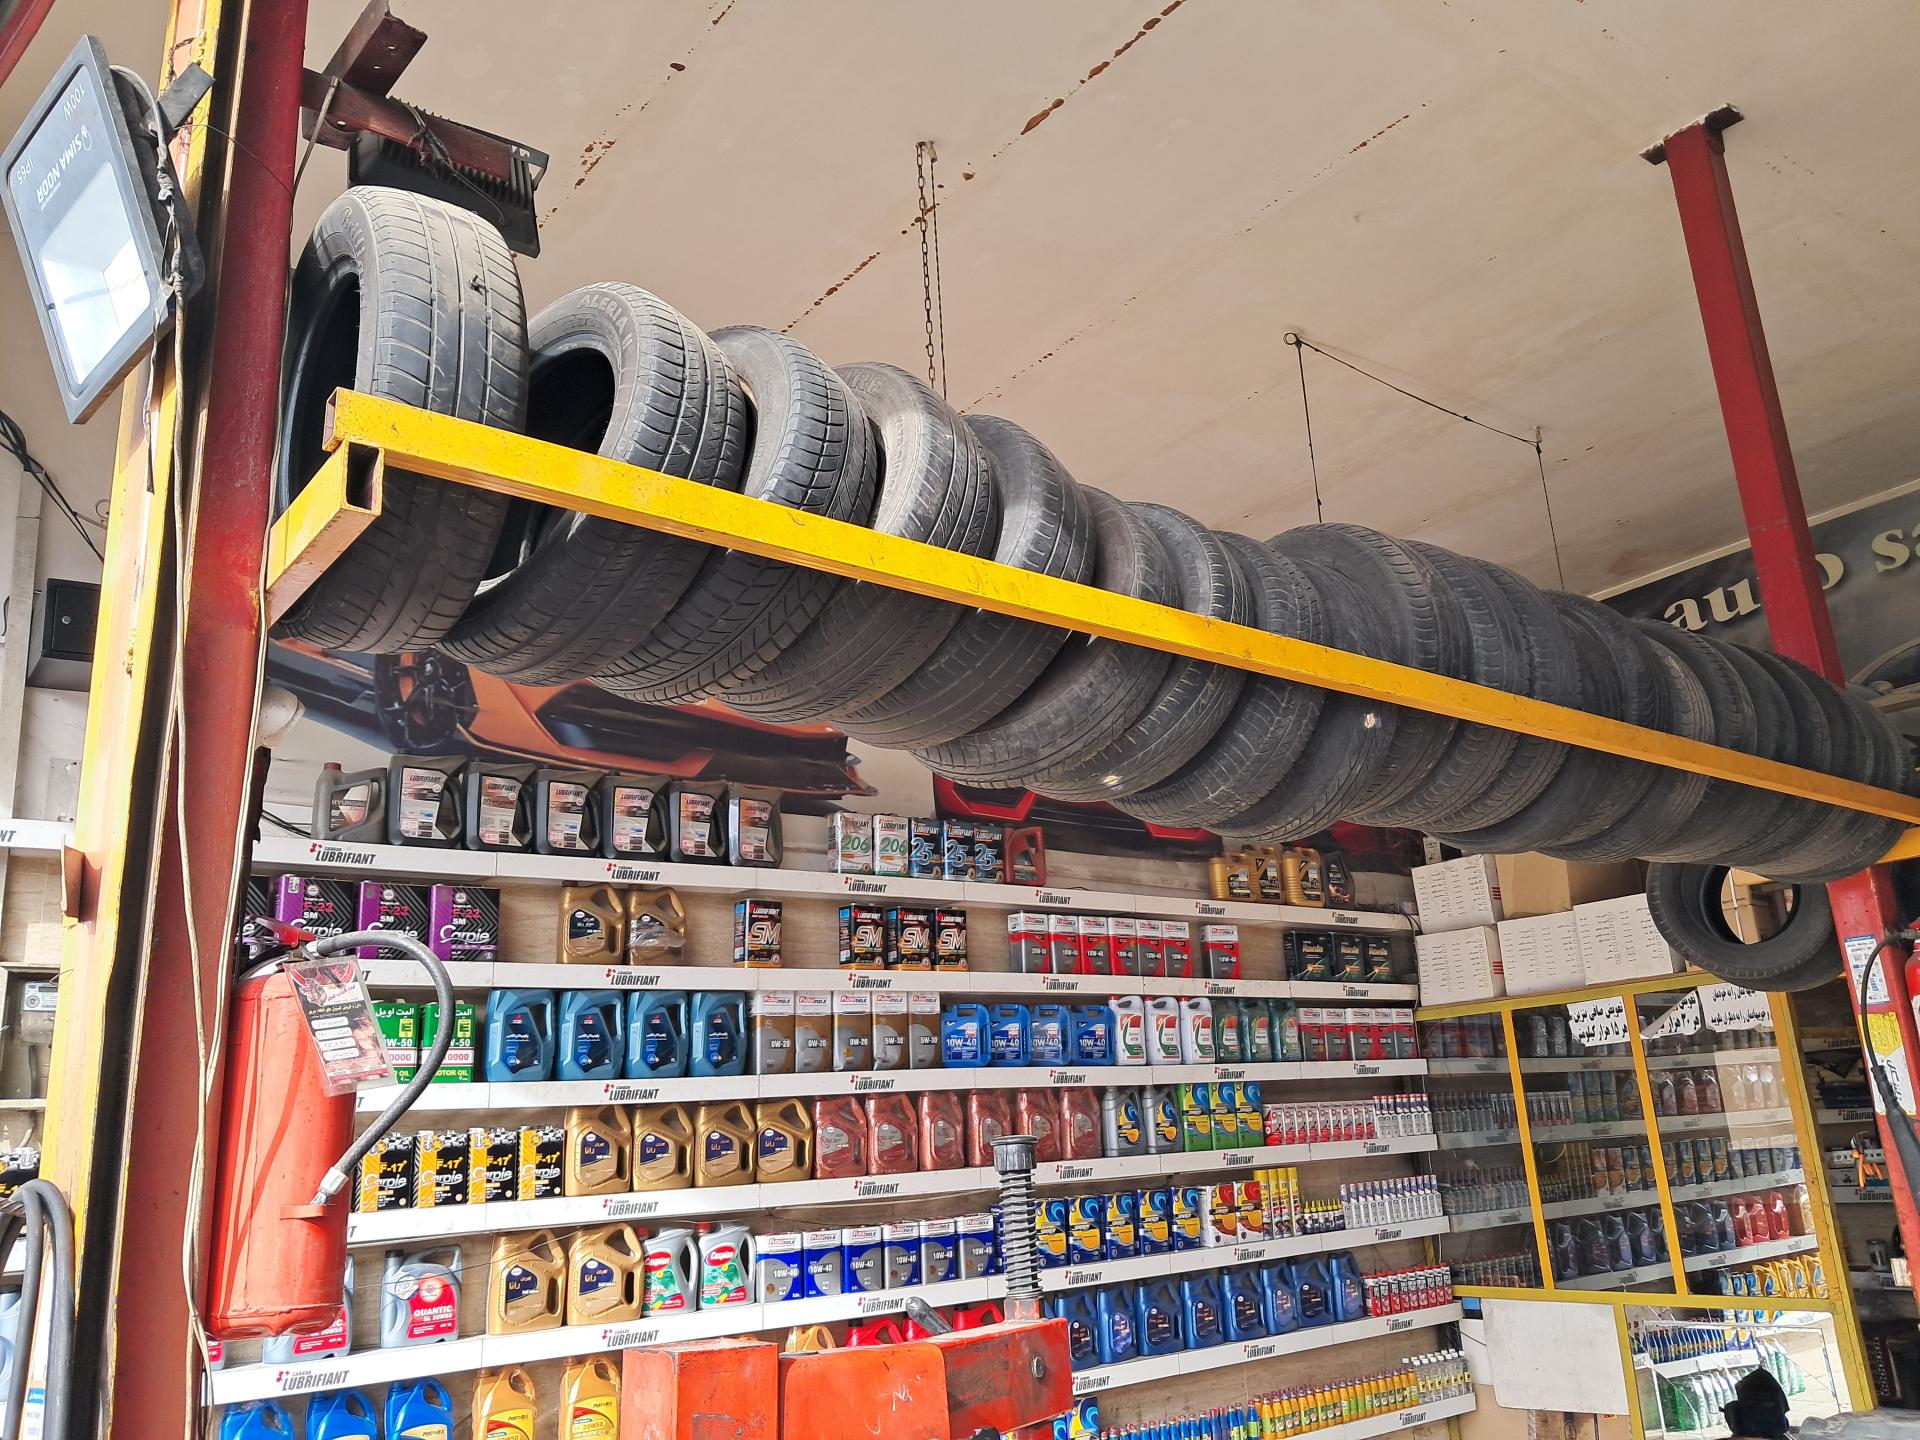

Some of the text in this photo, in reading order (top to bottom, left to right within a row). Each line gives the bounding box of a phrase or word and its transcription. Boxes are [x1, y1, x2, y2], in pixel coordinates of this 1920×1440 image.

[63, 84, 85, 120] 100W
[59, 134, 82, 171] SIMA
[16, 155, 34, 185] IP65
[36, 163, 61, 203] NOOR
[1663, 523, 1920, 631] auo s
[842, 836, 871, 852] 206
[880, 837, 907, 853] 206
[315, 850, 376, 865] LUBRIFIANT
[910, 837, 935, 866] 25
[944, 840, 967, 867] 25
[974, 843, 998, 871] 25
[611, 869, 661, 882] LUBRIFIANT
[849, 883, 888, 894] LUBRIFIANT
[1038, 894, 1072, 905] LUBRIFIANT
[303, 911, 318, 920] SM
[380, 915, 394, 923] SM
[749, 921, 781, 945] SM
[855, 926, 883, 948] SM
[902, 928, 930, 949] SM
[940, 928, 966, 950] SM
[610, 975, 661, 987] LUBRIFIANT
[852, 979, 892, 989] LUBRIFIANT
[1046, 979, 1079, 991] LUBRIFIANT
[375, 1007, 414, 1018] الیت اویل
[1574, 1001, 1623, 1023] تعویض صافی بنزین
[1610, 1020, 1619, 1035] ۱۵
[1668, 1015, 1680, 1033] هزار
[1693, 1015, 1700, 1030] هر
[1599, 1023, 1610, 1041] هزار
[1622, 1023, 1628, 1038] هر
[946, 1038, 977, 1047] 10W-40
[1032, 1038, 1059, 1048] 0W-40
[1079, 1038, 1106, 1047] 10W-40
[854, 1080, 895, 1091] LUBRIFIANT
[1053, 1074, 1087, 1084] LUBRIFIANT
[609, 1088, 660, 1101] LUBRIFIANT
[1059, 1168, 1093, 1179] LUBRIFIANT
[858, 1183, 900, 1196] LUBRIFIANT
[607, 1202, 659, 1216] LUBRIFIANT
[710, 1251, 734, 1261] Caspian
[933, 1251, 953, 1260] 10W-40
[972, 1247, 993, 1255] 10W-40
[852, 1260, 874, 1269] 10W-40
[896, 1255, 916, 1264] 10W-40
[773, 1269, 799, 1278] 10W-40
[809, 1264, 833, 1273] 10W-40
[1068, 1272, 1103, 1285] LUBRIFIANT
[413, 1305, 453, 1317] QUANTIC
[862, 1298, 904, 1314] LUBRIFIANT
[607, 1330, 659, 1347] LUBRIFIANT
[282, 1370, 349, 1391] LUBRIFIANT
[1075, 1376, 1110, 1392] LUBRIFIANT
